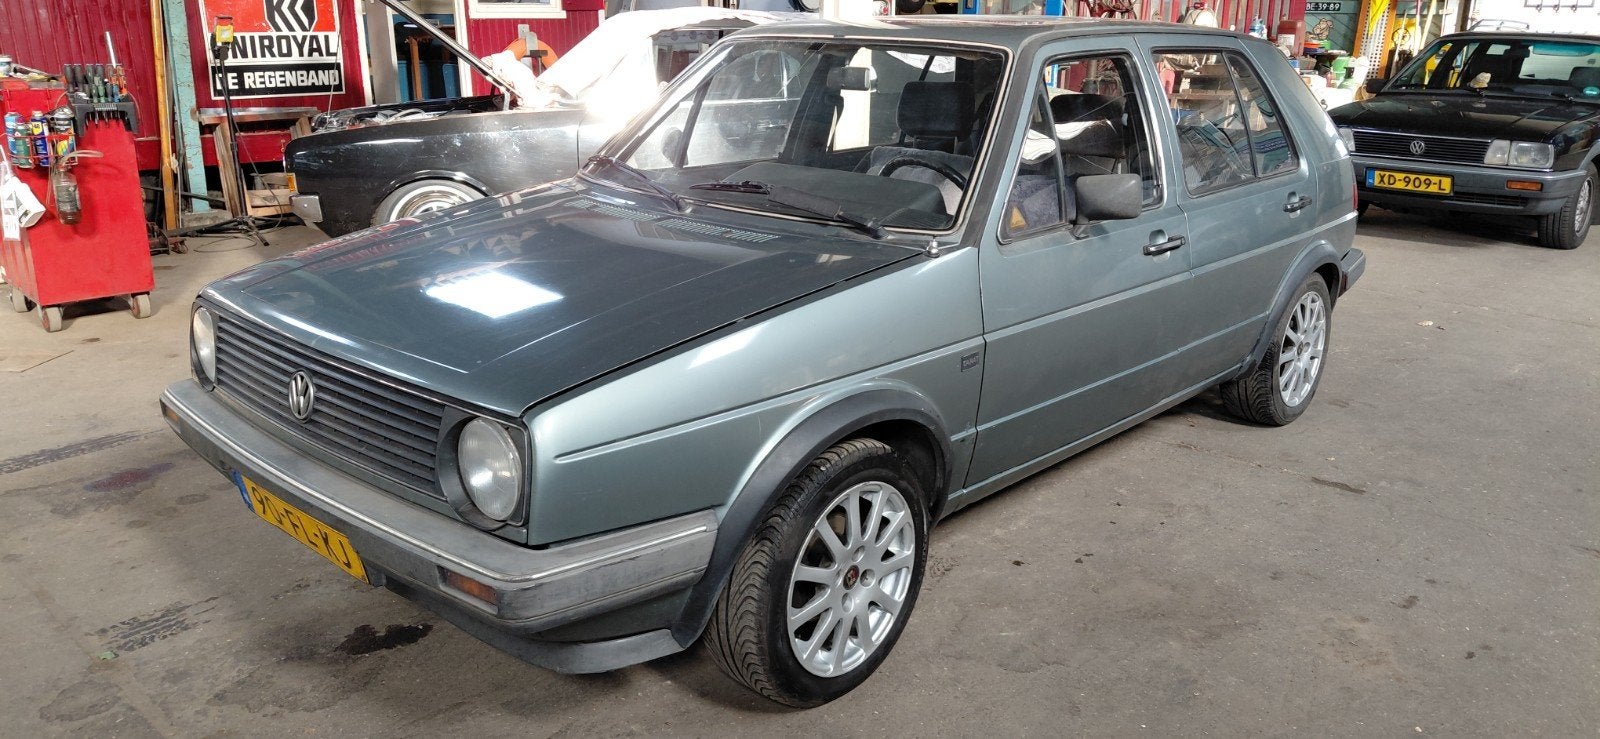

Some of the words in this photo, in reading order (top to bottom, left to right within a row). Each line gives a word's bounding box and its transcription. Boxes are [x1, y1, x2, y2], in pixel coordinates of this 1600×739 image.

[243, 69, 340, 89] REGENBAND
[1377, 173, 1446, 191] XD-909-L
[251, 485, 352, 569] 90-FL-KJ
